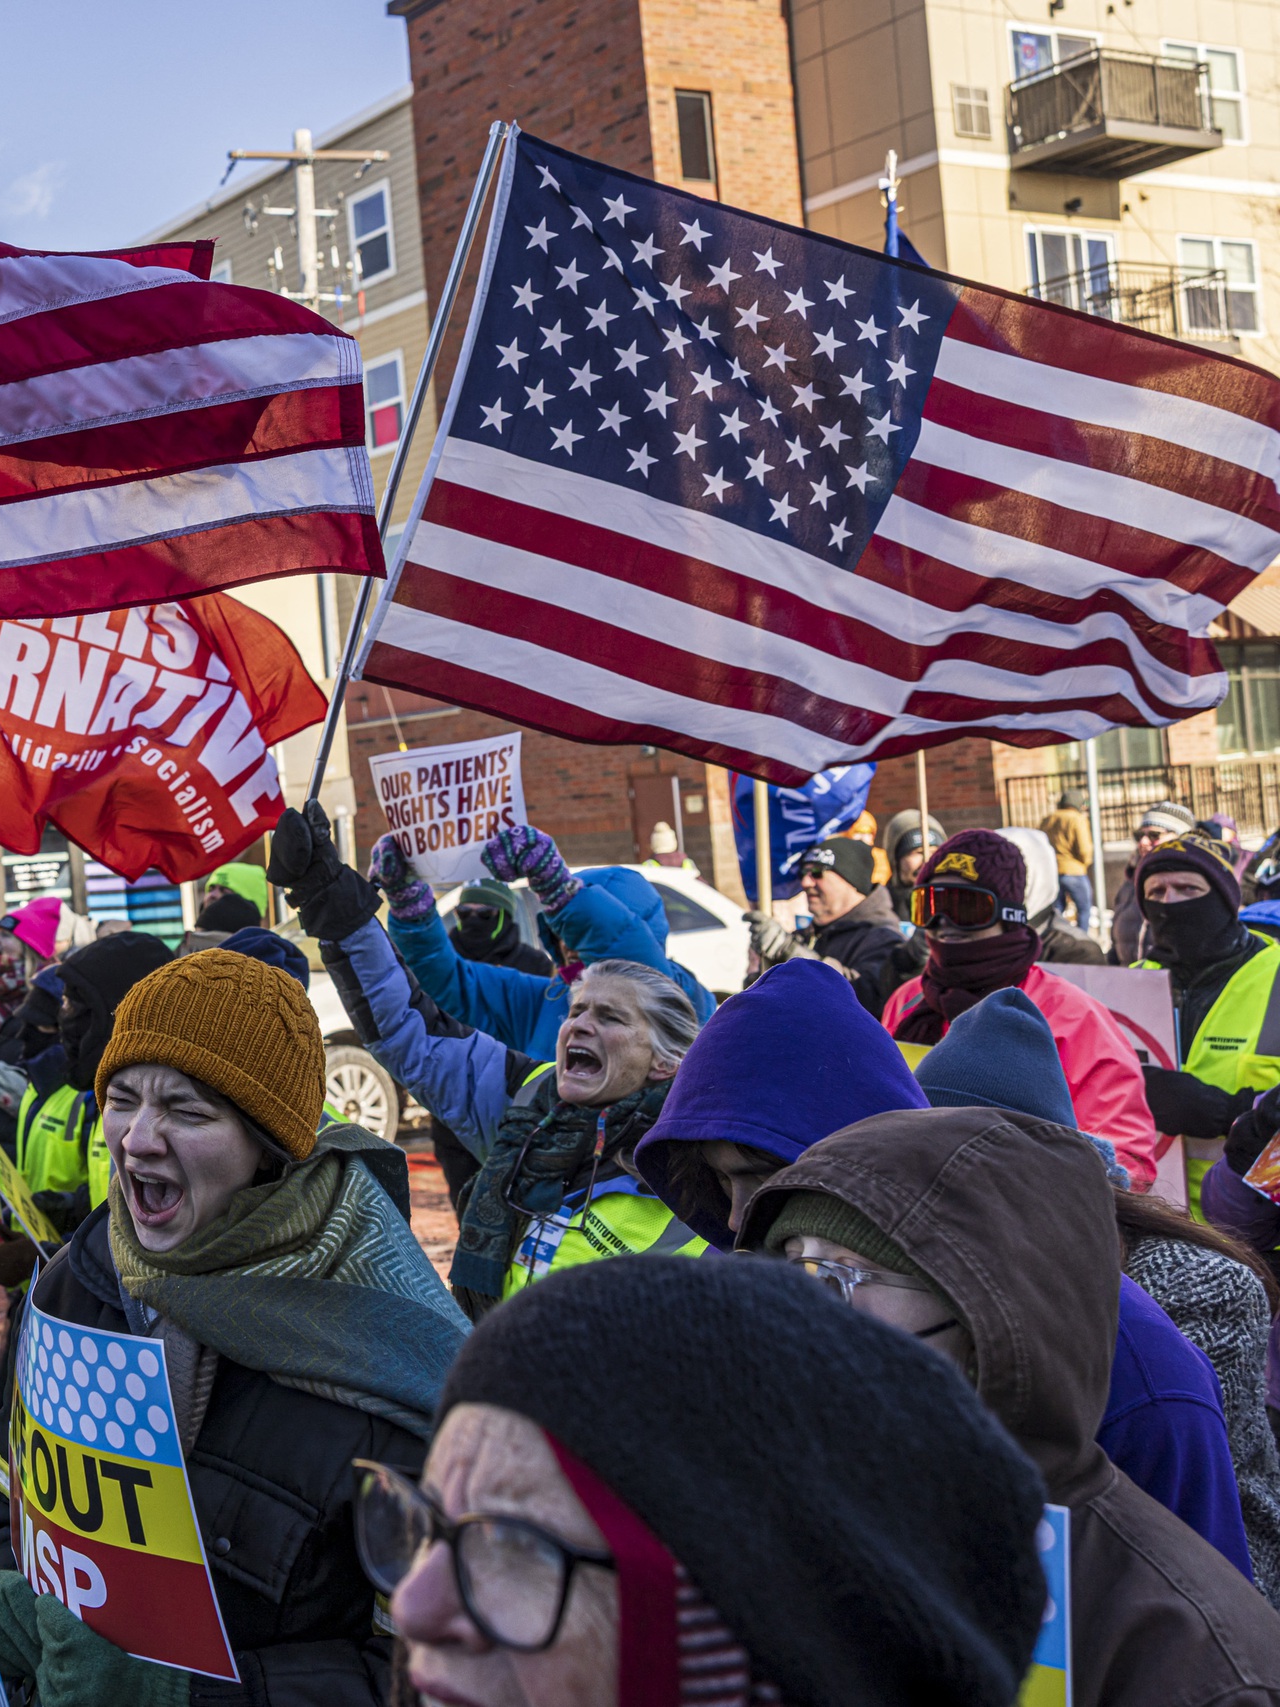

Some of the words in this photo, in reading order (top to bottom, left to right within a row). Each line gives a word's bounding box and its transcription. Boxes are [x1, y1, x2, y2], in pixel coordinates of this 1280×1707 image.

[380, 771, 412, 802] OUR
[385, 789, 450, 832] RIGHTS
[457, 774, 513, 815] HAVE
[414, 806, 516, 855] BORDERS
[31, 1429, 154, 1547] OUT
[20, 1495, 108, 1623] MSP
